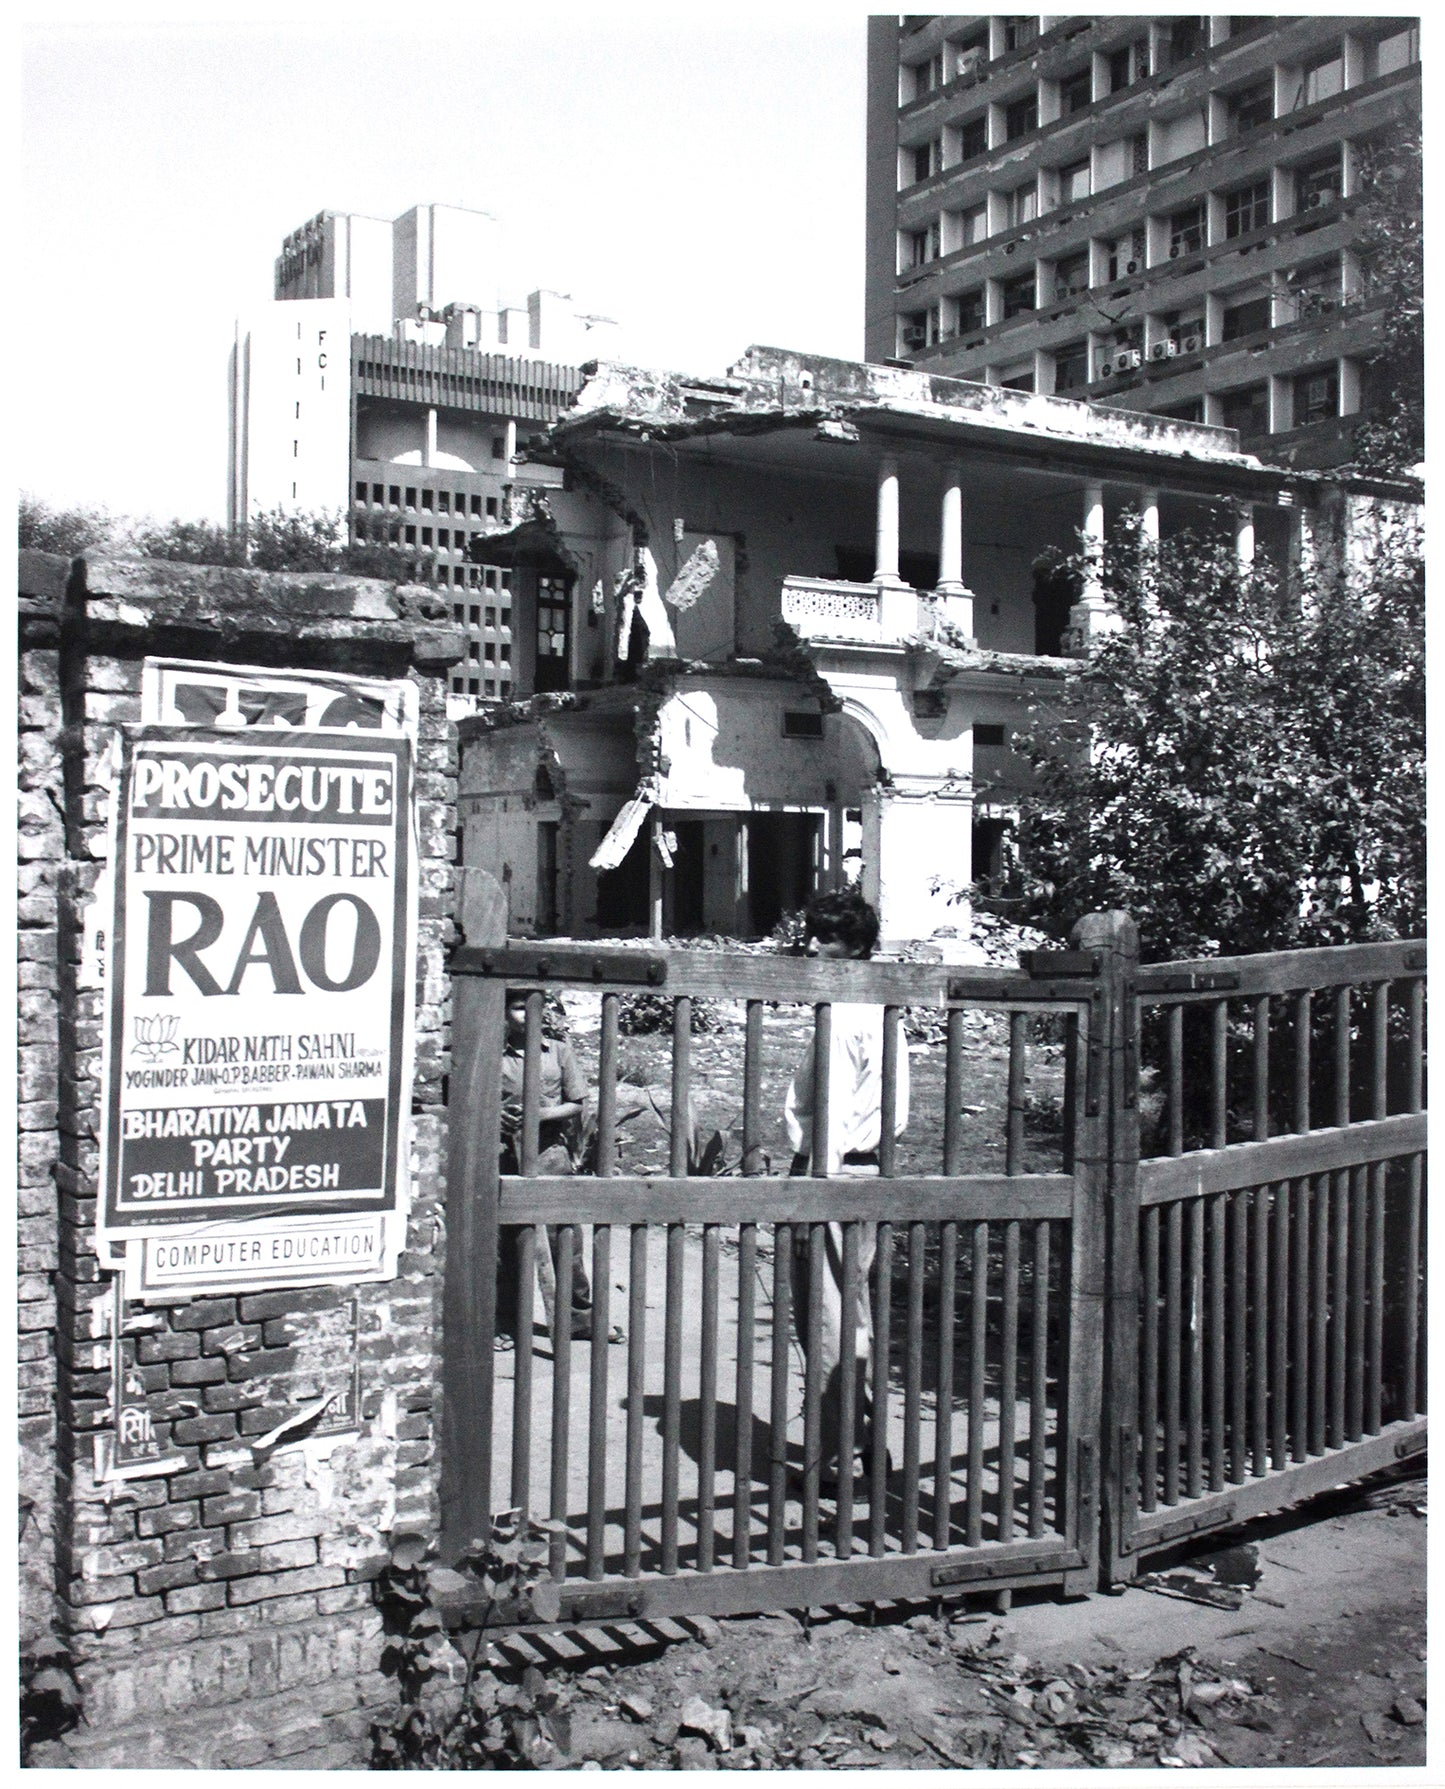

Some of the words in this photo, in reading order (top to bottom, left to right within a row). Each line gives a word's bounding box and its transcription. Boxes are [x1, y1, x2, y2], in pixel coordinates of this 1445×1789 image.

[132, 759, 392, 815] PROSECUTE
[133, 833, 235, 875] PRIME
[244, 835, 389, 878] MINISTER
[141, 890, 381, 997] RAO
[182, 1036, 240, 1065] KIDAR
[243, 1034, 292, 1062] NATH
[298, 1032, 355, 1060] SAHNI
[125, 1067, 188, 1089] YOGINDER
[338, 1061, 383, 1079] SHARMA
[123, 1105, 260, 1140] BHARATIYA
[265, 1101, 367, 1133] JANATA
[191, 1136, 291, 1167] PARTY
[130, 1170, 203, 1198] DELHI
[214, 1163, 340, 1194] PRADESH
[156, 1241, 261, 1268] COMPUTER
[272, 1234, 373, 1259] EDUCATION
